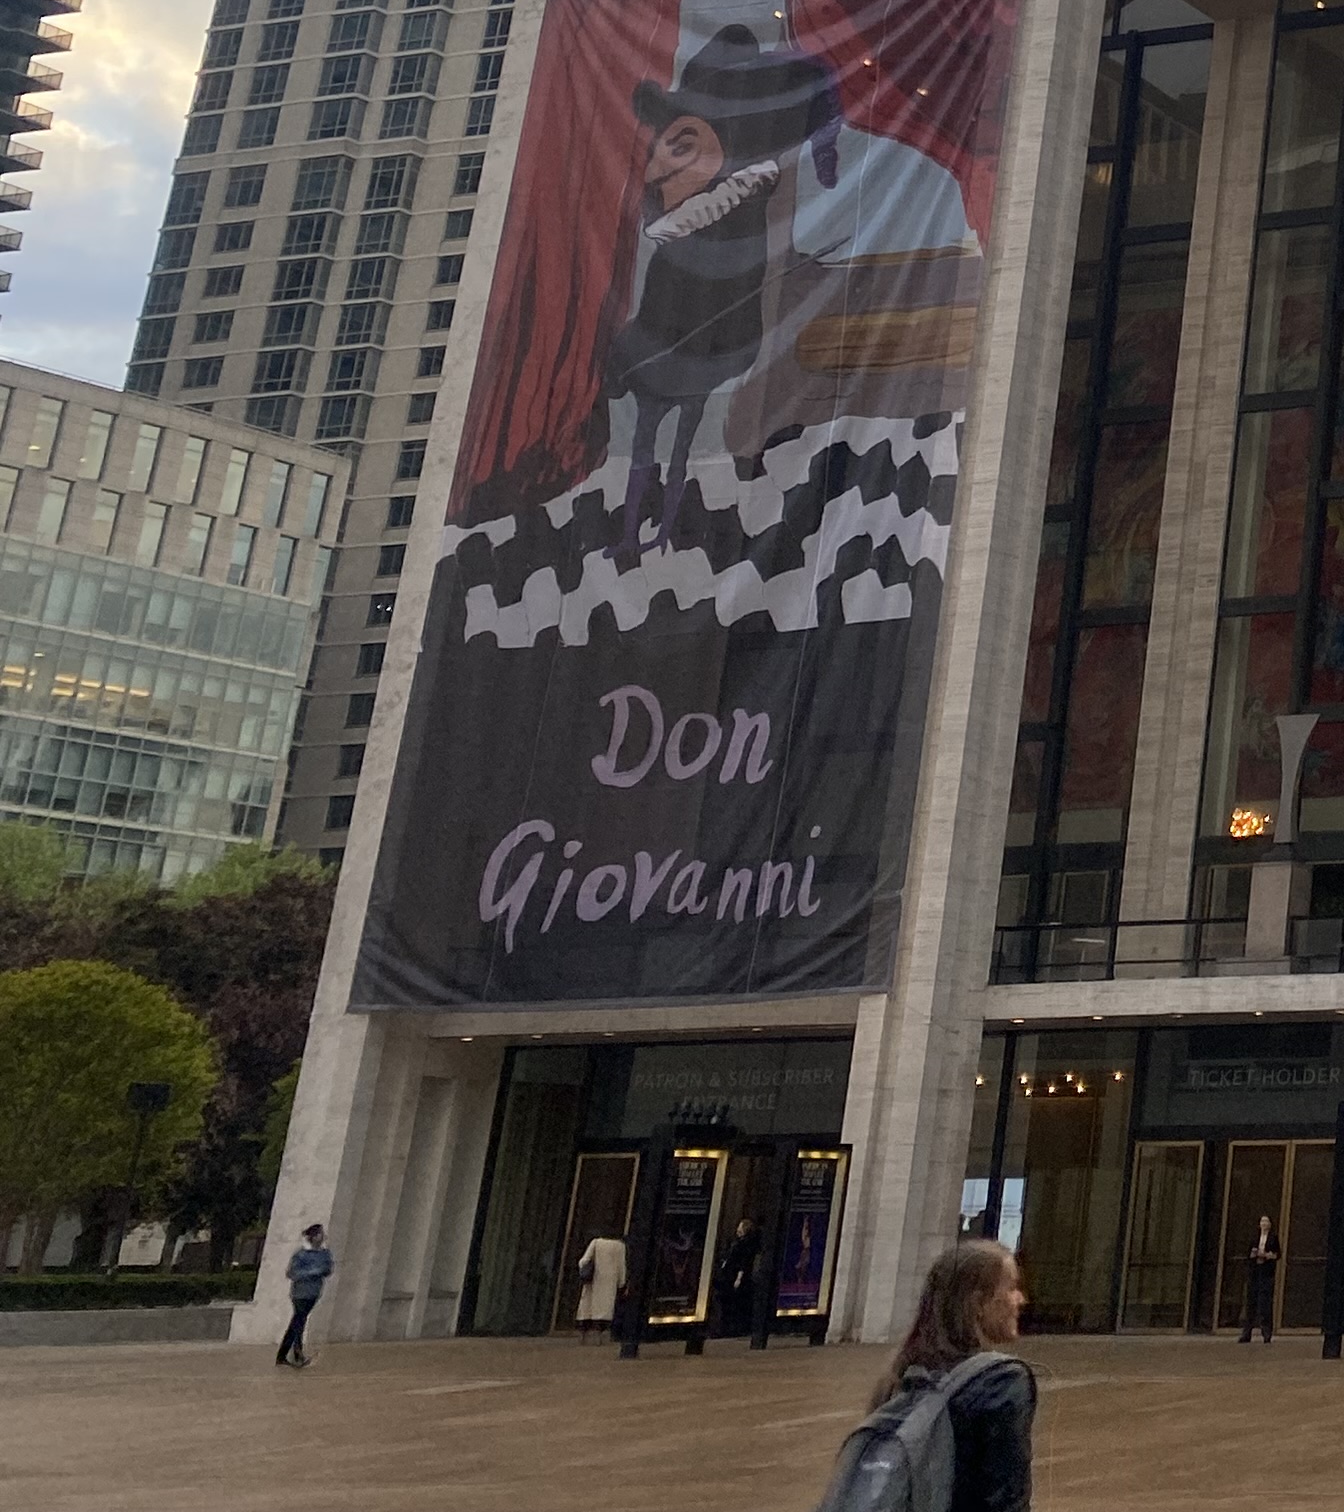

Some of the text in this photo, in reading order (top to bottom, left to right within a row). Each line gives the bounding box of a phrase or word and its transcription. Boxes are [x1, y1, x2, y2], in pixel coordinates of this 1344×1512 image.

[591, 684, 774, 788] Don
[479, 819, 821, 954] Giovanni
[632, 1073, 703, 1090] PATRON
[1189, 1066, 1341, 1087] TICKET-HOLDER
